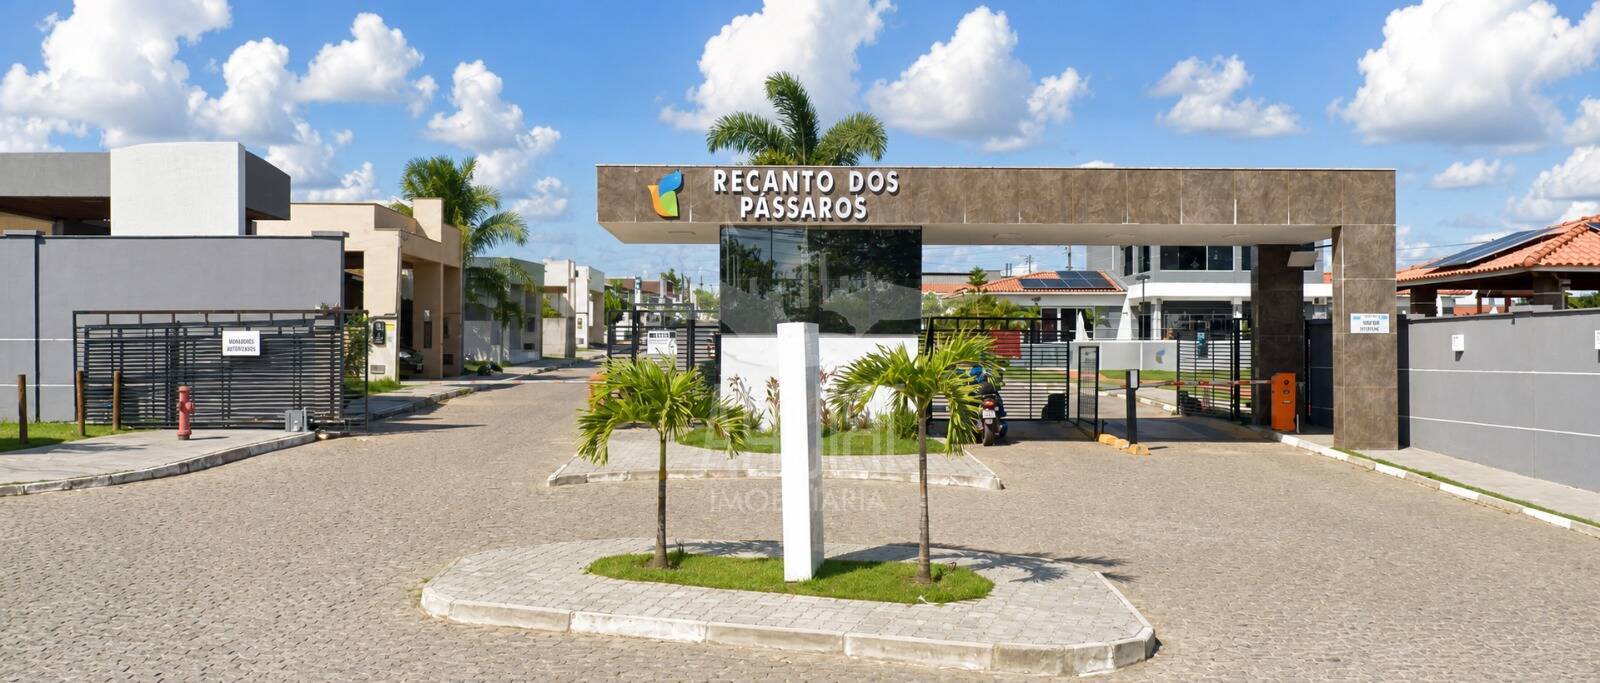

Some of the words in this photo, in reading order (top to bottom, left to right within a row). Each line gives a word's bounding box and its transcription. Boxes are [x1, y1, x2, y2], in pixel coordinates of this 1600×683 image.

[713, 169, 835, 193] RECANTO
[849, 170, 900, 193] DOS
[740, 192, 868, 219] PÁSSAROS
